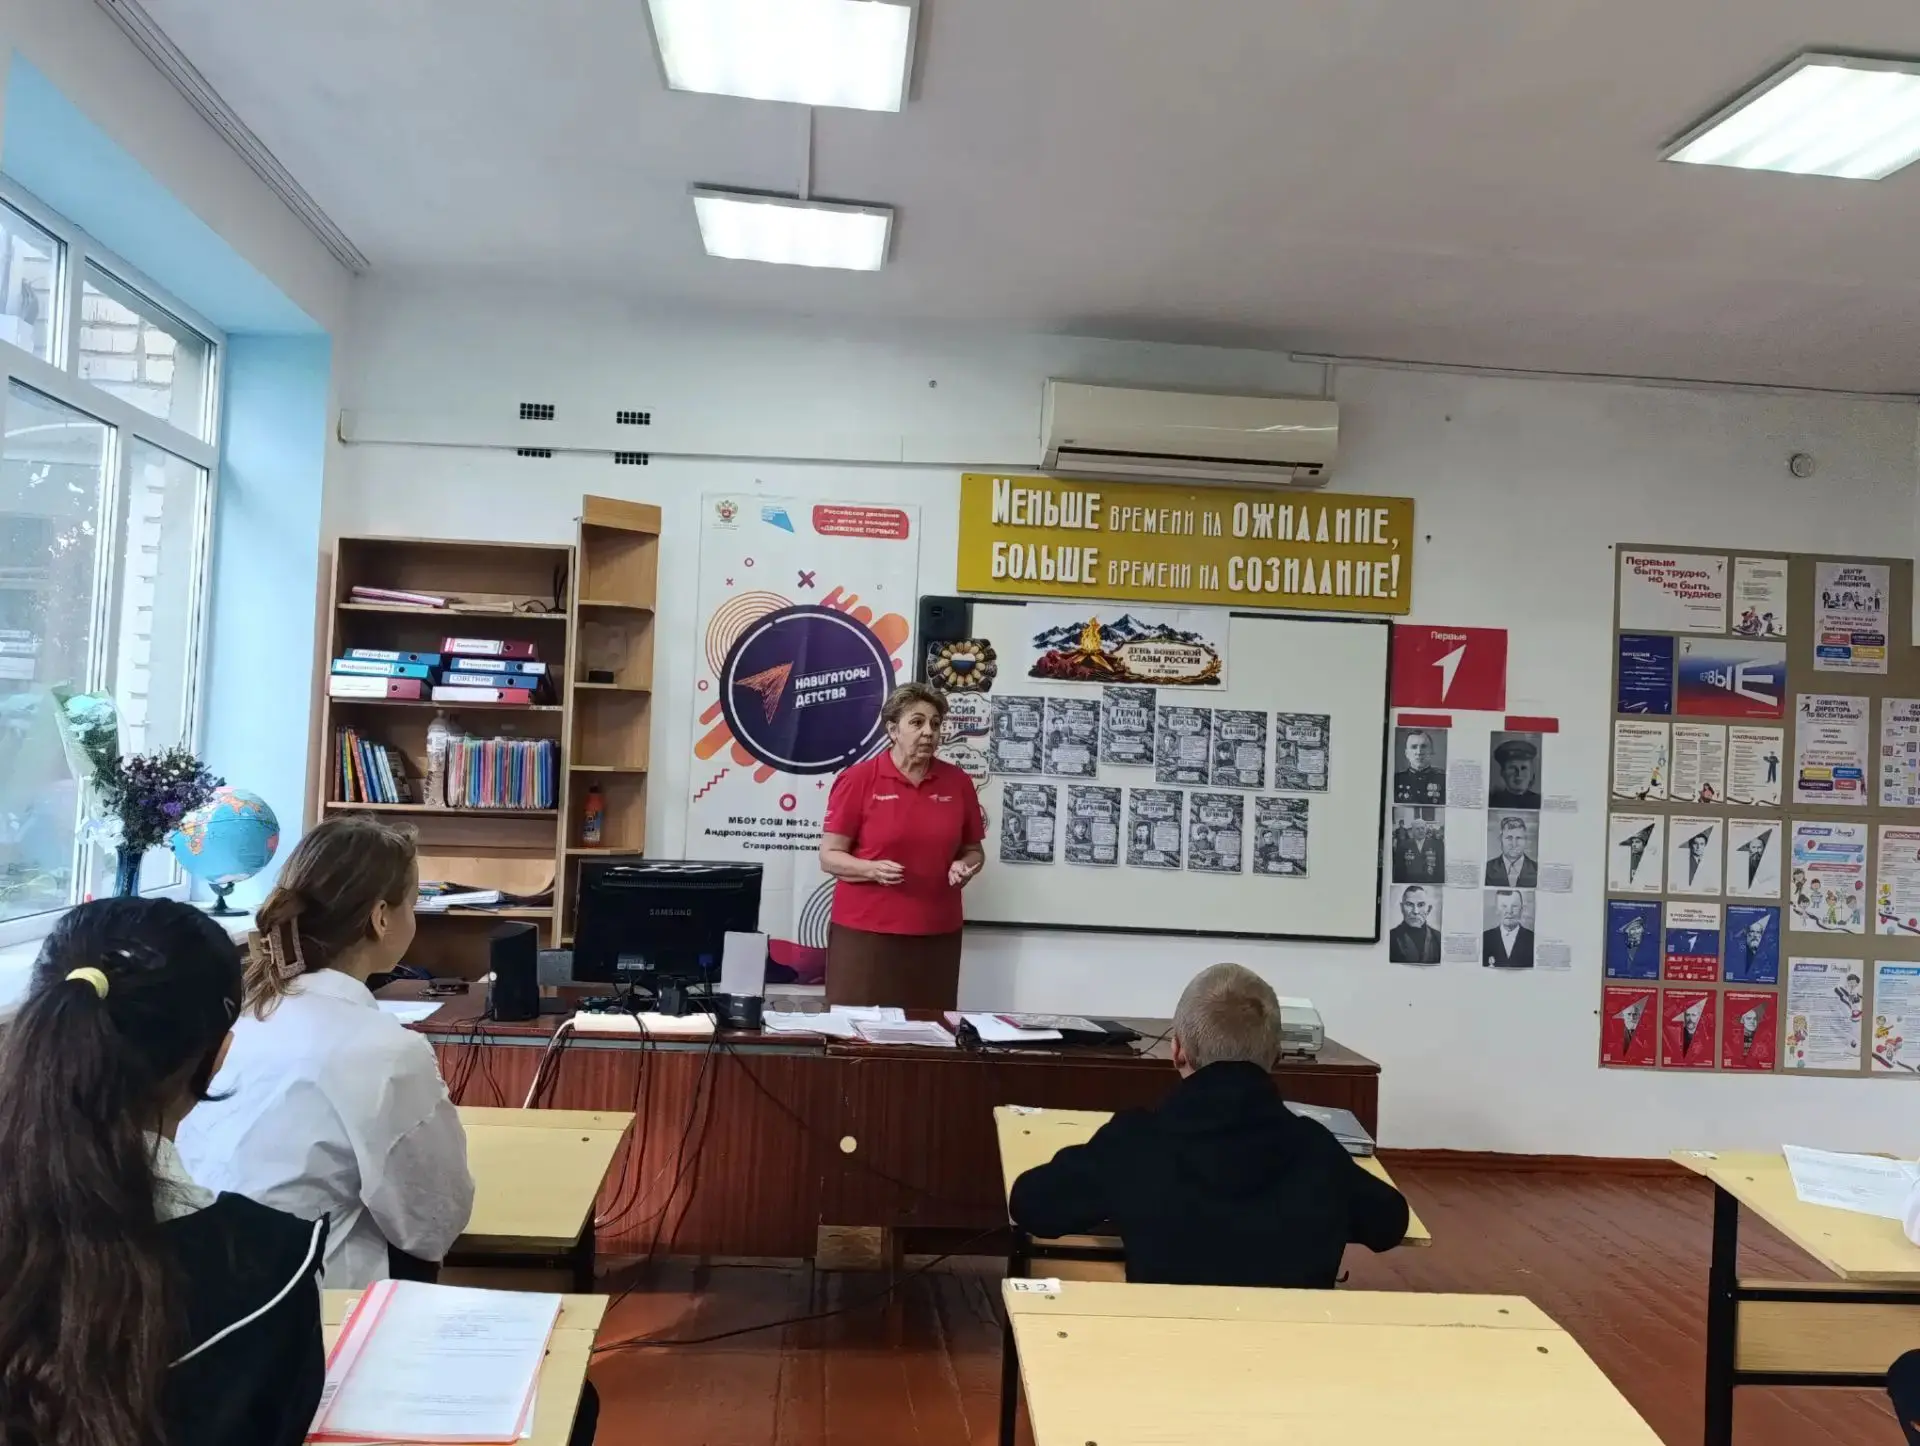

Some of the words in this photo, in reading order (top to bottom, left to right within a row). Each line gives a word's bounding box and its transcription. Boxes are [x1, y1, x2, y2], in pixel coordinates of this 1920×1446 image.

[1109, 505, 1194, 535] ВРЕМЕНИ
[1203, 511, 1222, 537] НА
[1232, 502, 1399, 549] ОЖИДАНИЕ,
[1625, 556, 1676, 567] Первым
[991, 541, 1099, 584] БОЛЬШЕ
[1108, 560, 1191, 589] ВРЕМЕНИ
[1199, 564, 1219, 590] НА
[1228, 554, 1400, 598] СОЗИДАНИЕ!
[1634, 566, 1665, 576] быть
[1666, 569, 1710, 579] трудно,
[1679, 581, 1710, 590] быть
[1673, 590, 1722, 599] труднее
[1431, 631, 1467, 642] Первые
[1164, 656, 1201, 664] РОССИИ
[795, 667, 870, 690] НАВИГАТОРЫ
[795, 687, 847, 708] ДЕТСТВА
[728, 816, 757, 824] МБОУ
[760, 818, 783, 826] СОШ
[786, 819, 809, 827] №12
[704, 828, 776, 838] Андроповский
